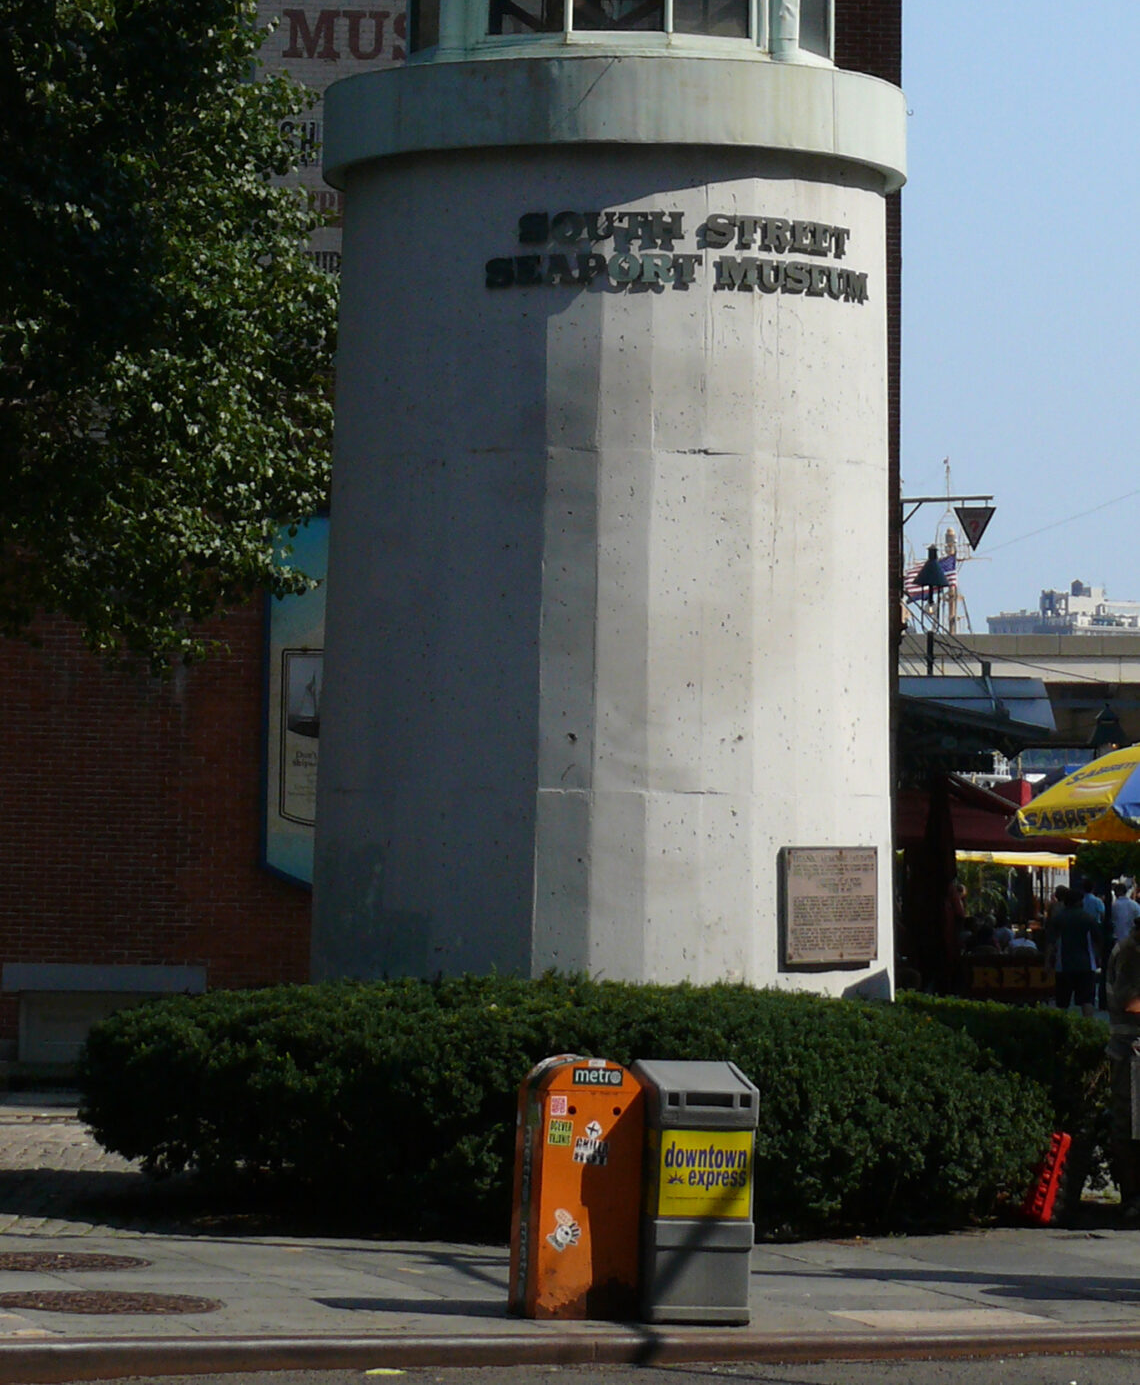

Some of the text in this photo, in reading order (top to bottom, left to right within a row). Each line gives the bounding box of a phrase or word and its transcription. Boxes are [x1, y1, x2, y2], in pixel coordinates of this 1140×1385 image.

[517, 210, 851, 257] SOUTH STREET
[485, 253, 869, 304] SEAPORT MUSEUM
[575, 1068, 622, 1084] metro
[665, 1141, 747, 1169] downtown
[688, 1169, 747, 1192] express
